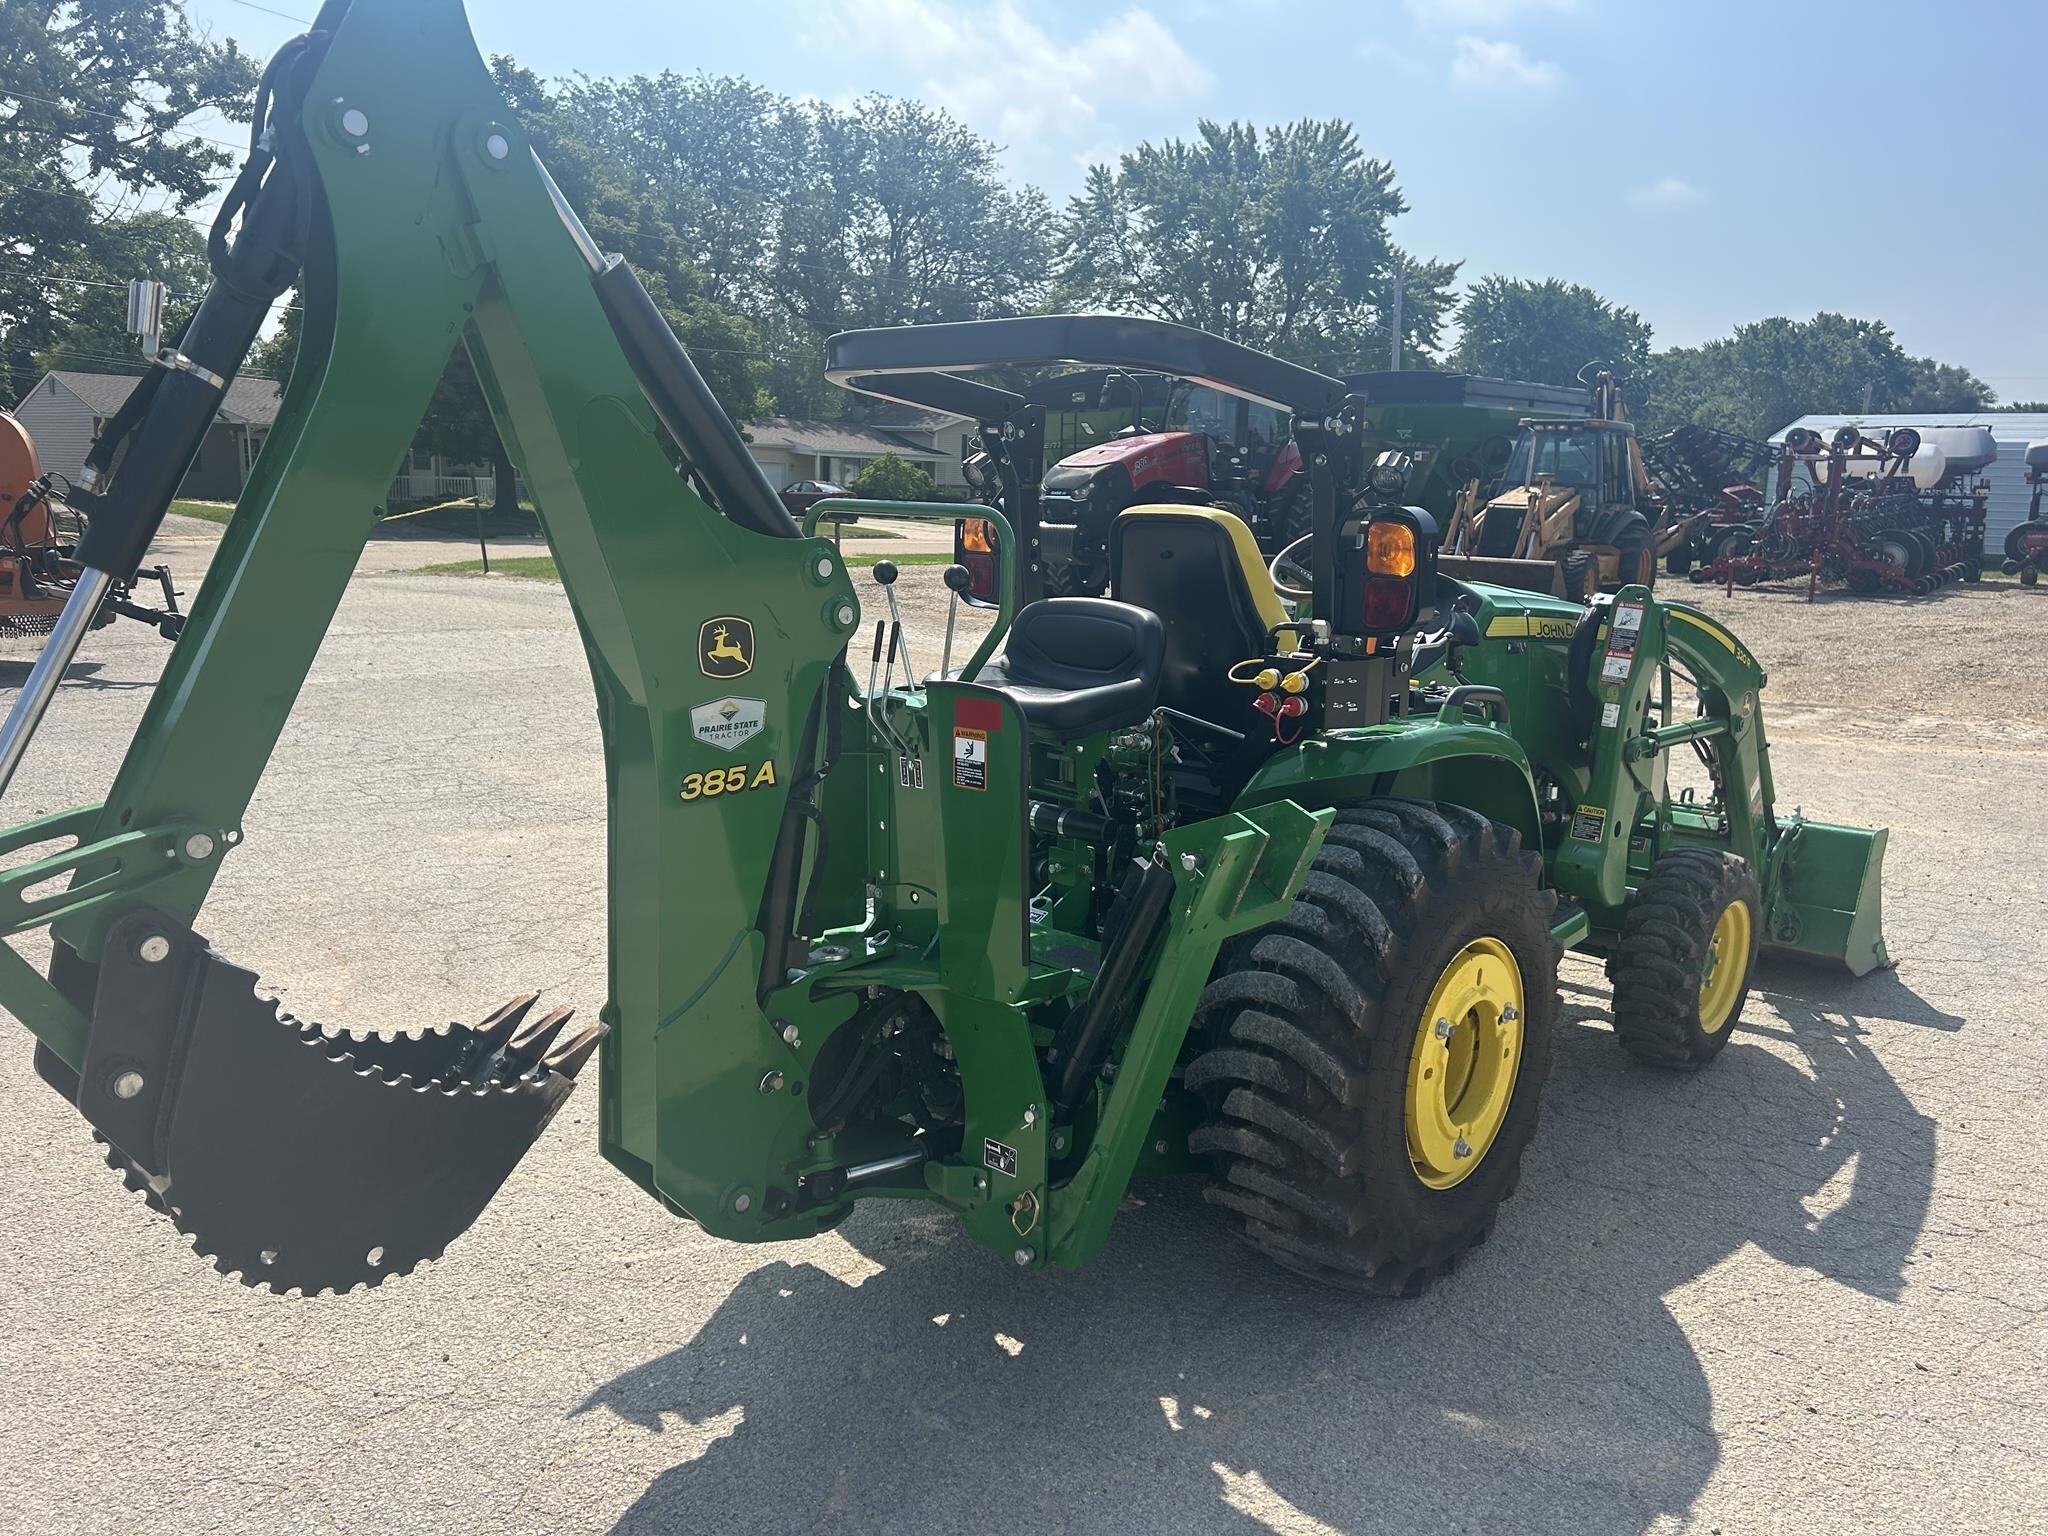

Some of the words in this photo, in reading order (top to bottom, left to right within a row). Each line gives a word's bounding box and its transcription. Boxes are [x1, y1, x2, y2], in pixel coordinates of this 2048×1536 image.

[1536, 621, 1565, 637] JOHN
[698, 723, 733, 734] PRAIRIE
[733, 720, 759, 729] STATE
[709, 730, 749, 740] TRACTOR
[680, 764, 748, 801] 385
[750, 760, 776, 789] A
[1583, 807, 1605, 815] CAUTION
